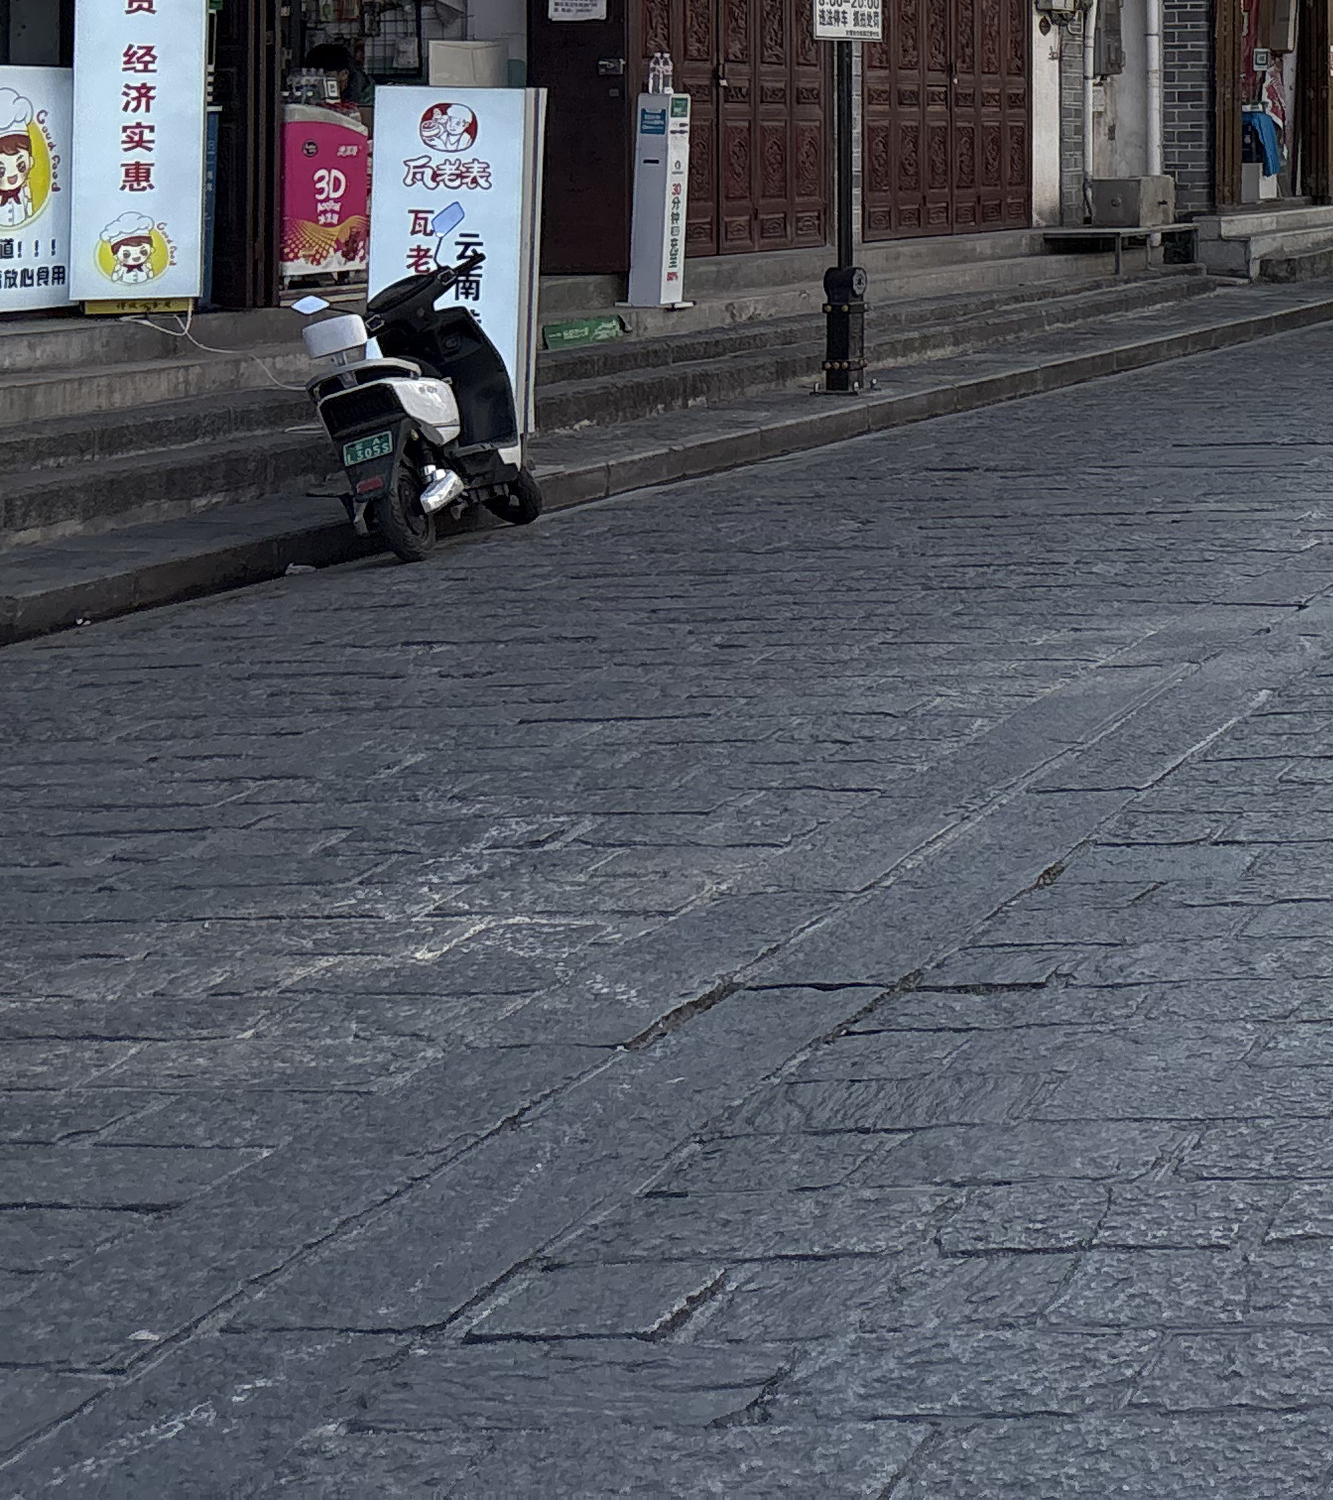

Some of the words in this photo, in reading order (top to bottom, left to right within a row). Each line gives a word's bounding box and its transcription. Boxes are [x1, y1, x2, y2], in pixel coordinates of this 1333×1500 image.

[119, 42, 158, 193] 经济实惠
[313, 168, 347, 201] 3D
[454, 232, 484, 324] 云南
